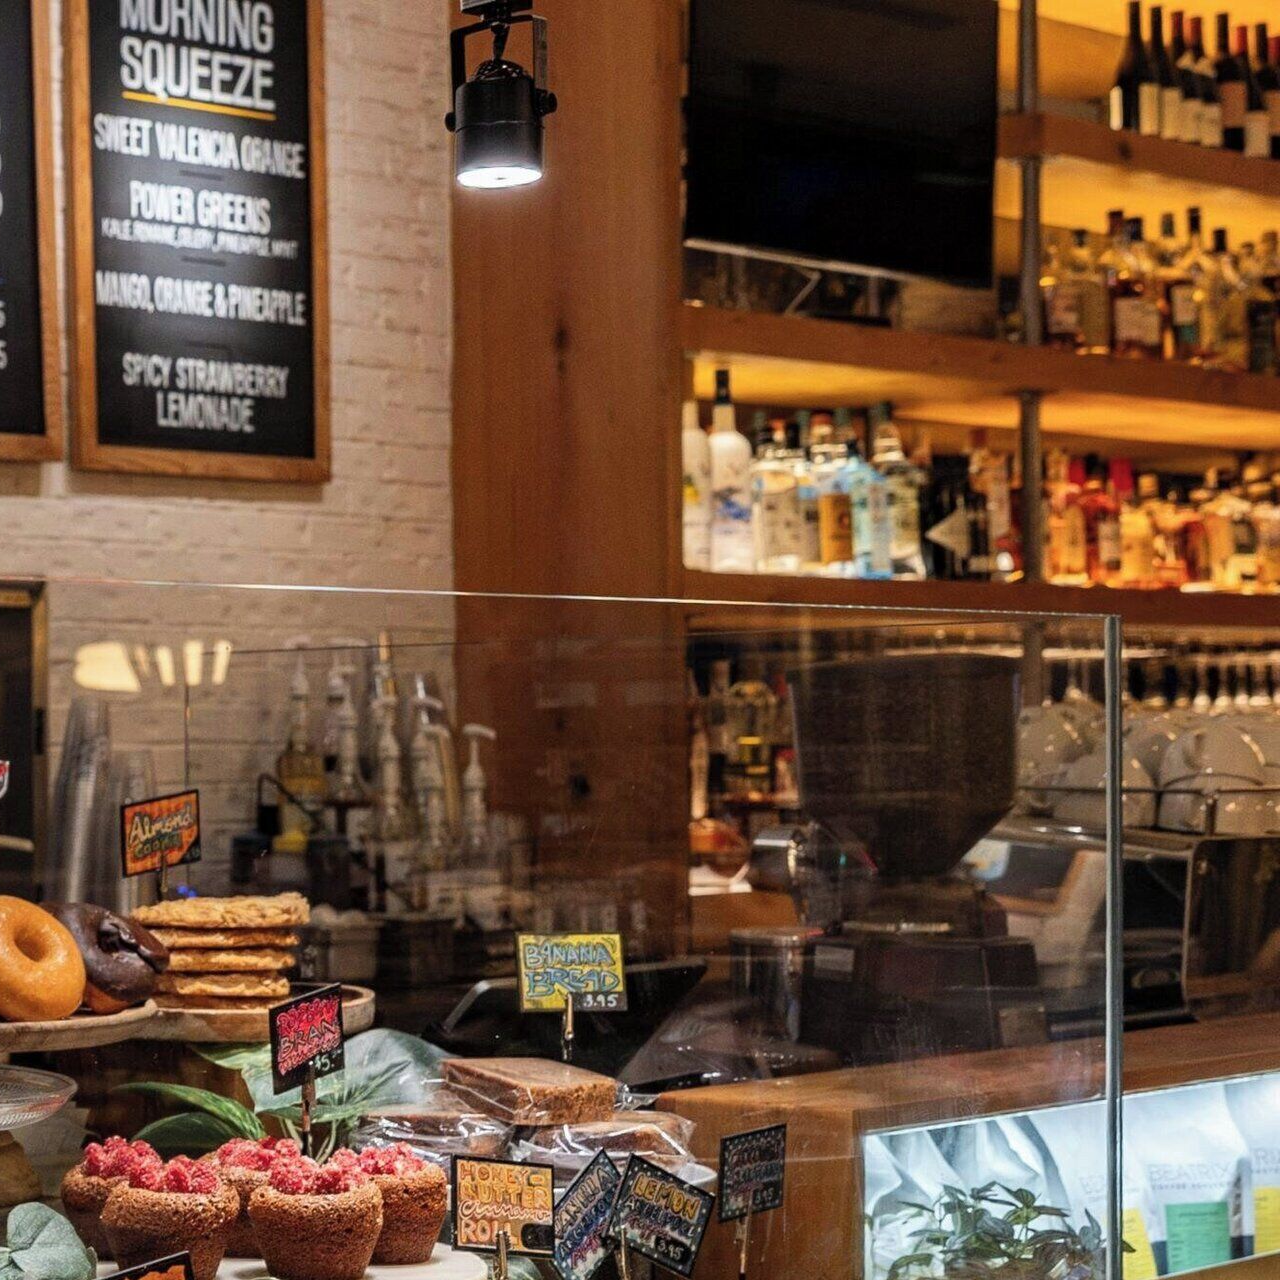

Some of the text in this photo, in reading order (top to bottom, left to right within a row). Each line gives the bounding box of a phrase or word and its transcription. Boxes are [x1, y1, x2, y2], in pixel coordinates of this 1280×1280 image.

[119, 0, 274, 54] MORNING
[120, 36, 276, 111] SQUEEZE
[94, 113, 153, 158] SWEET
[155, 121, 240, 170] VALENCIA
[130, 181, 271, 235] POWER GREENS
[154, 276, 213, 317] ORANGE
[228, 284, 306, 326] PINEAPPLE
[122, 351, 290, 398] SPICY STRAWBERRY
[156, 391, 255, 433] LEMONADE
[130, 806, 194, 844] Almond
[525, 942, 615, 969] BANANA
[526, 968, 620, 997] BREAD
[584, 994, 619, 1007] 3.95
[460, 1181, 549, 1211] BUTTER
[633, 1173, 701, 1220] LEMON
